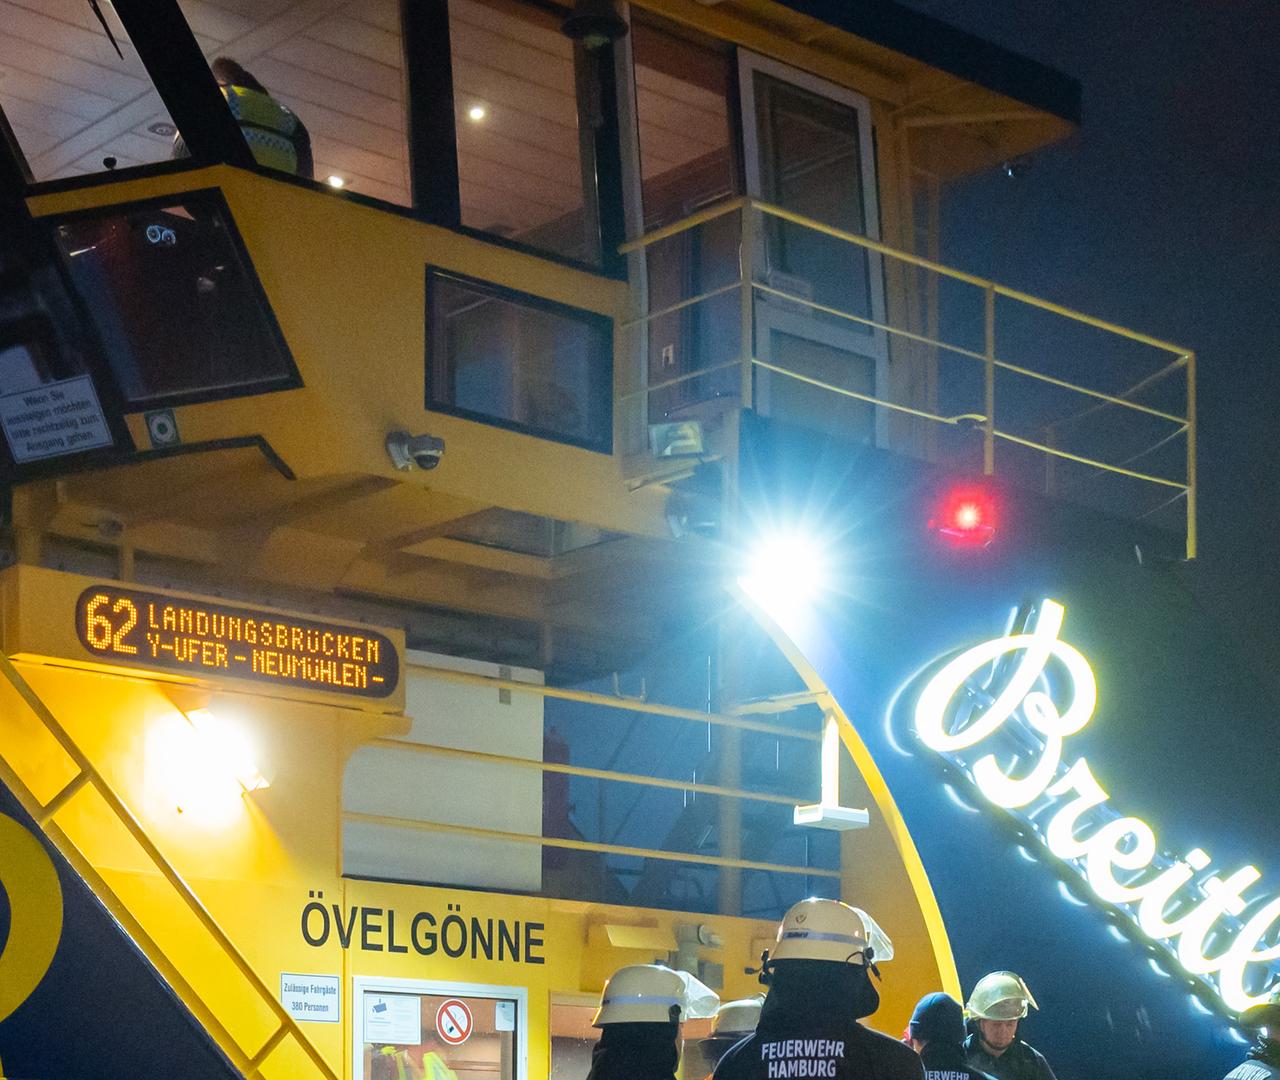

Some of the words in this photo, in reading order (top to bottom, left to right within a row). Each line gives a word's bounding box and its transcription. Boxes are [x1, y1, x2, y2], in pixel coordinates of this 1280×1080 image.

[86, 594, 138, 656] 62
[148, 602, 380, 664] LANDUNGSBRÜCKEN
[146, 632, 229, 668] Y-UFER
[252, 649, 368, 689] NEUMÜHLEN
[301, 890, 546, 965] ÖVELGÖNNE
[284, 982, 309, 994] Zulässige
[310, 984, 336, 996] Fahrgäste
[304, 1002, 329, 1011] Personen
[761, 1039, 845, 1061] FEUERWEHR
[768, 1060, 837, 1079] HAMBURG
